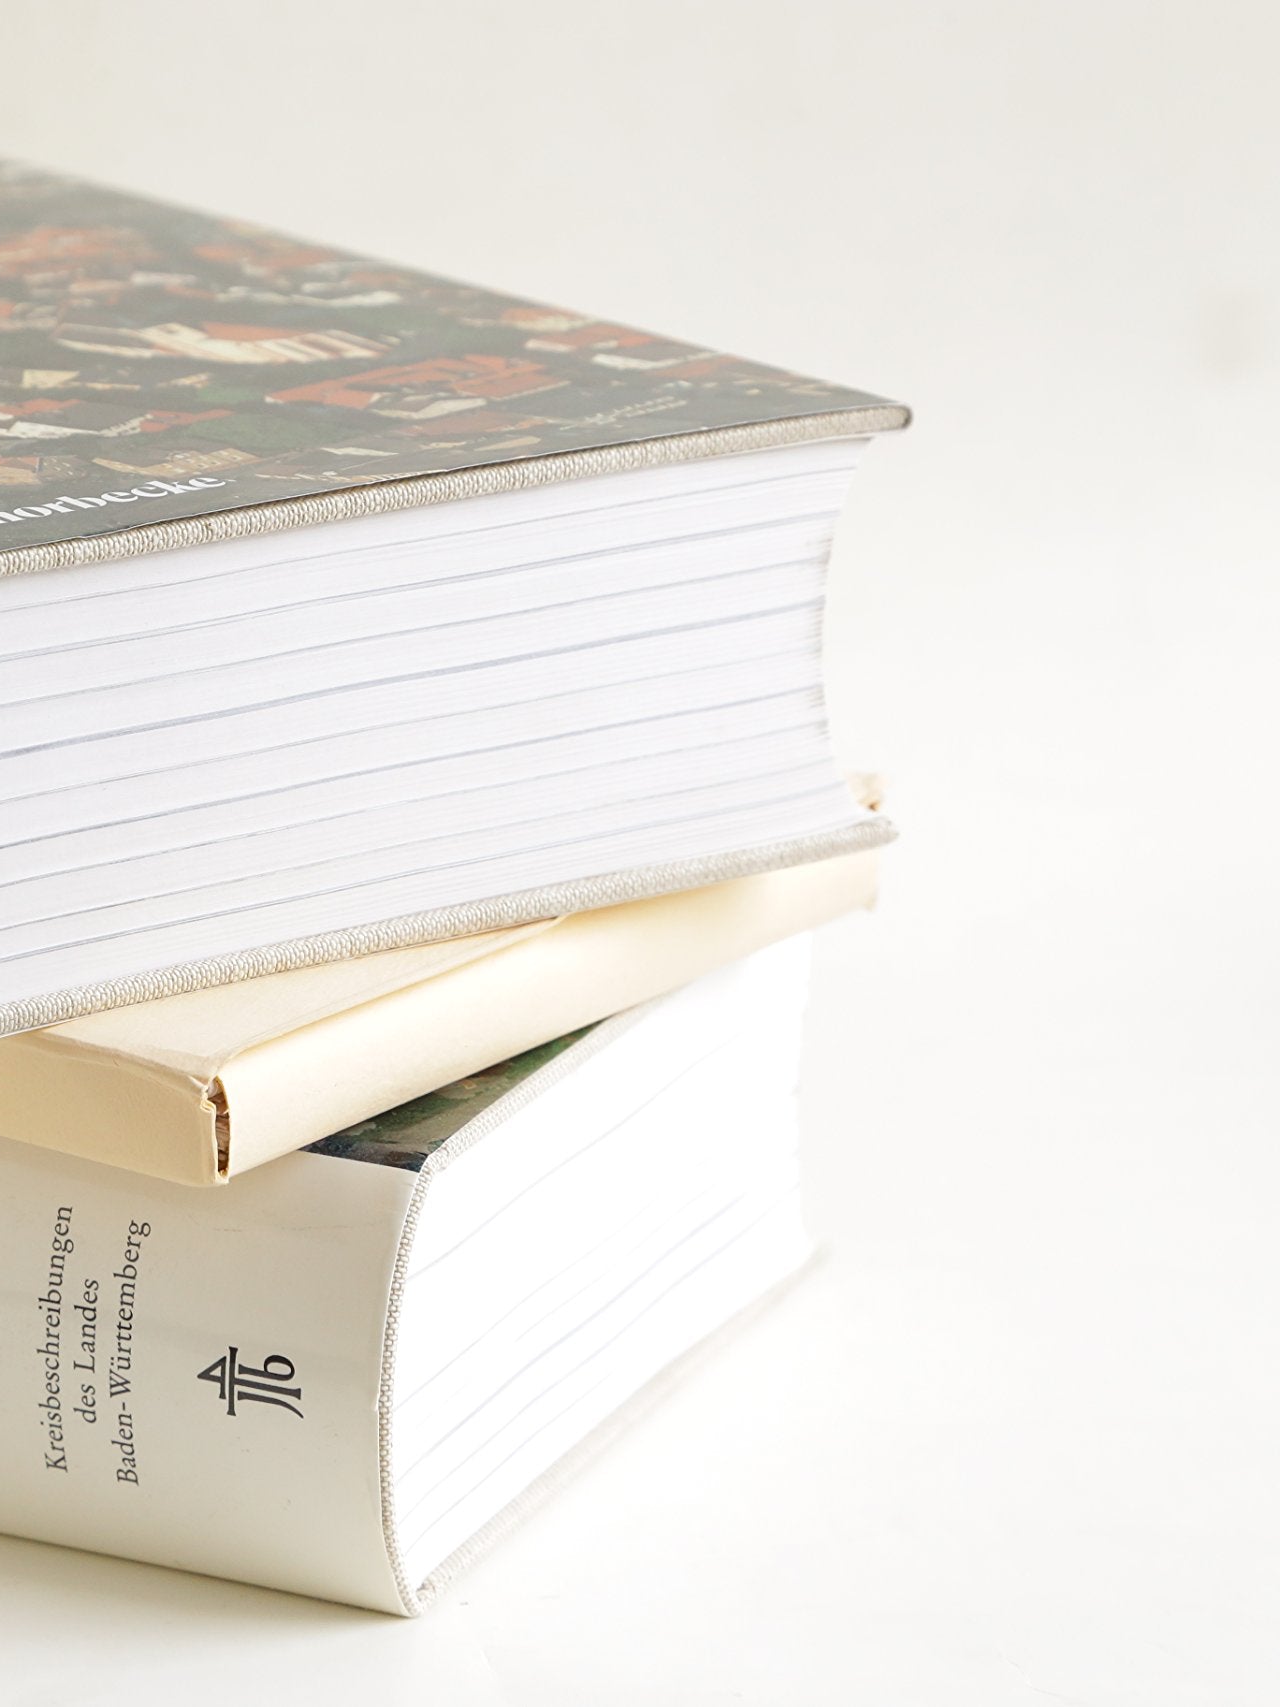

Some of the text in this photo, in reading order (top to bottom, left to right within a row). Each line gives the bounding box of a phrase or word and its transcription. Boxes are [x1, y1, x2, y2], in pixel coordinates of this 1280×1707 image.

[36, 1205, 74, 1473] Kreisbeschreibungen
[72, 1278, 100, 1424] des Landes
